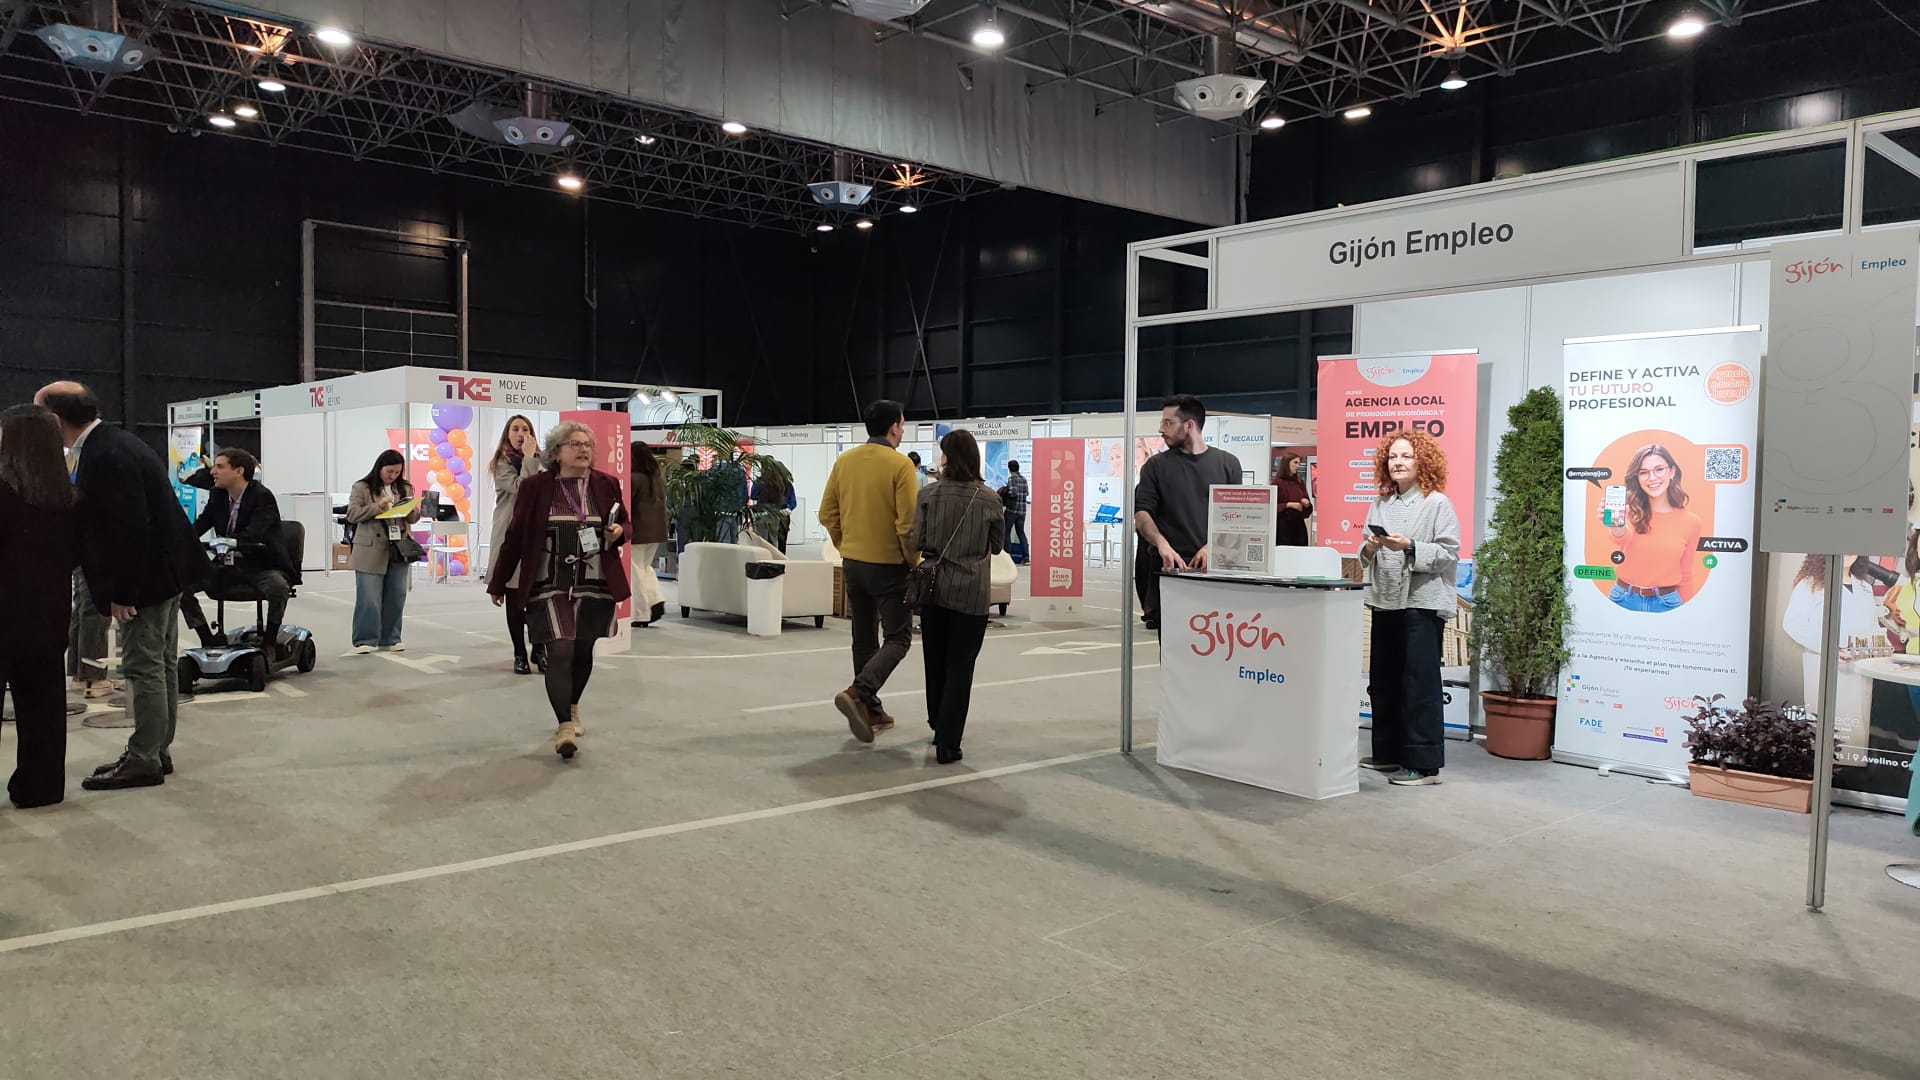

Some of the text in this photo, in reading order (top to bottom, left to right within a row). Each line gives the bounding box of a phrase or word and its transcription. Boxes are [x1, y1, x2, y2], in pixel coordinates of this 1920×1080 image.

[1329, 222, 1514, 268] Gijón Empleo
[1785, 257, 1907, 283] gijón Empleo
[1569, 365, 1700, 382] DEFINE Y ACTIVA
[438, 375, 491, 402] TKE
[499, 380, 527, 391] MOVE
[1569, 382, 1654, 396] TU FUTURO
[505, 394, 547, 406] BEYOND
[1345, 395, 1445, 407] AGENCIA LOCAL
[1569, 396, 1677, 410] PROFESIONAL
[1230, 434, 1265, 442] MECALUX
[1051, 494, 1061, 514] DE
[1063, 480, 1075, 558] DESCANSO
[1050, 518, 1061, 558] ZONA
[1703, 540, 1742, 549] ACTIVA
[1578, 568, 1612, 577] DEFINE
[1189, 610, 1285, 662] gijón
[1620, 657, 1645, 665] escucha
[1653, 660, 1667, 668] plan
[1682, 664, 1711, 672] tenemos
[1239, 666, 1285, 684] Empleo
[1579, 717, 1603, 728] FADE
[1861, 755, 1899, 767] Avelino
